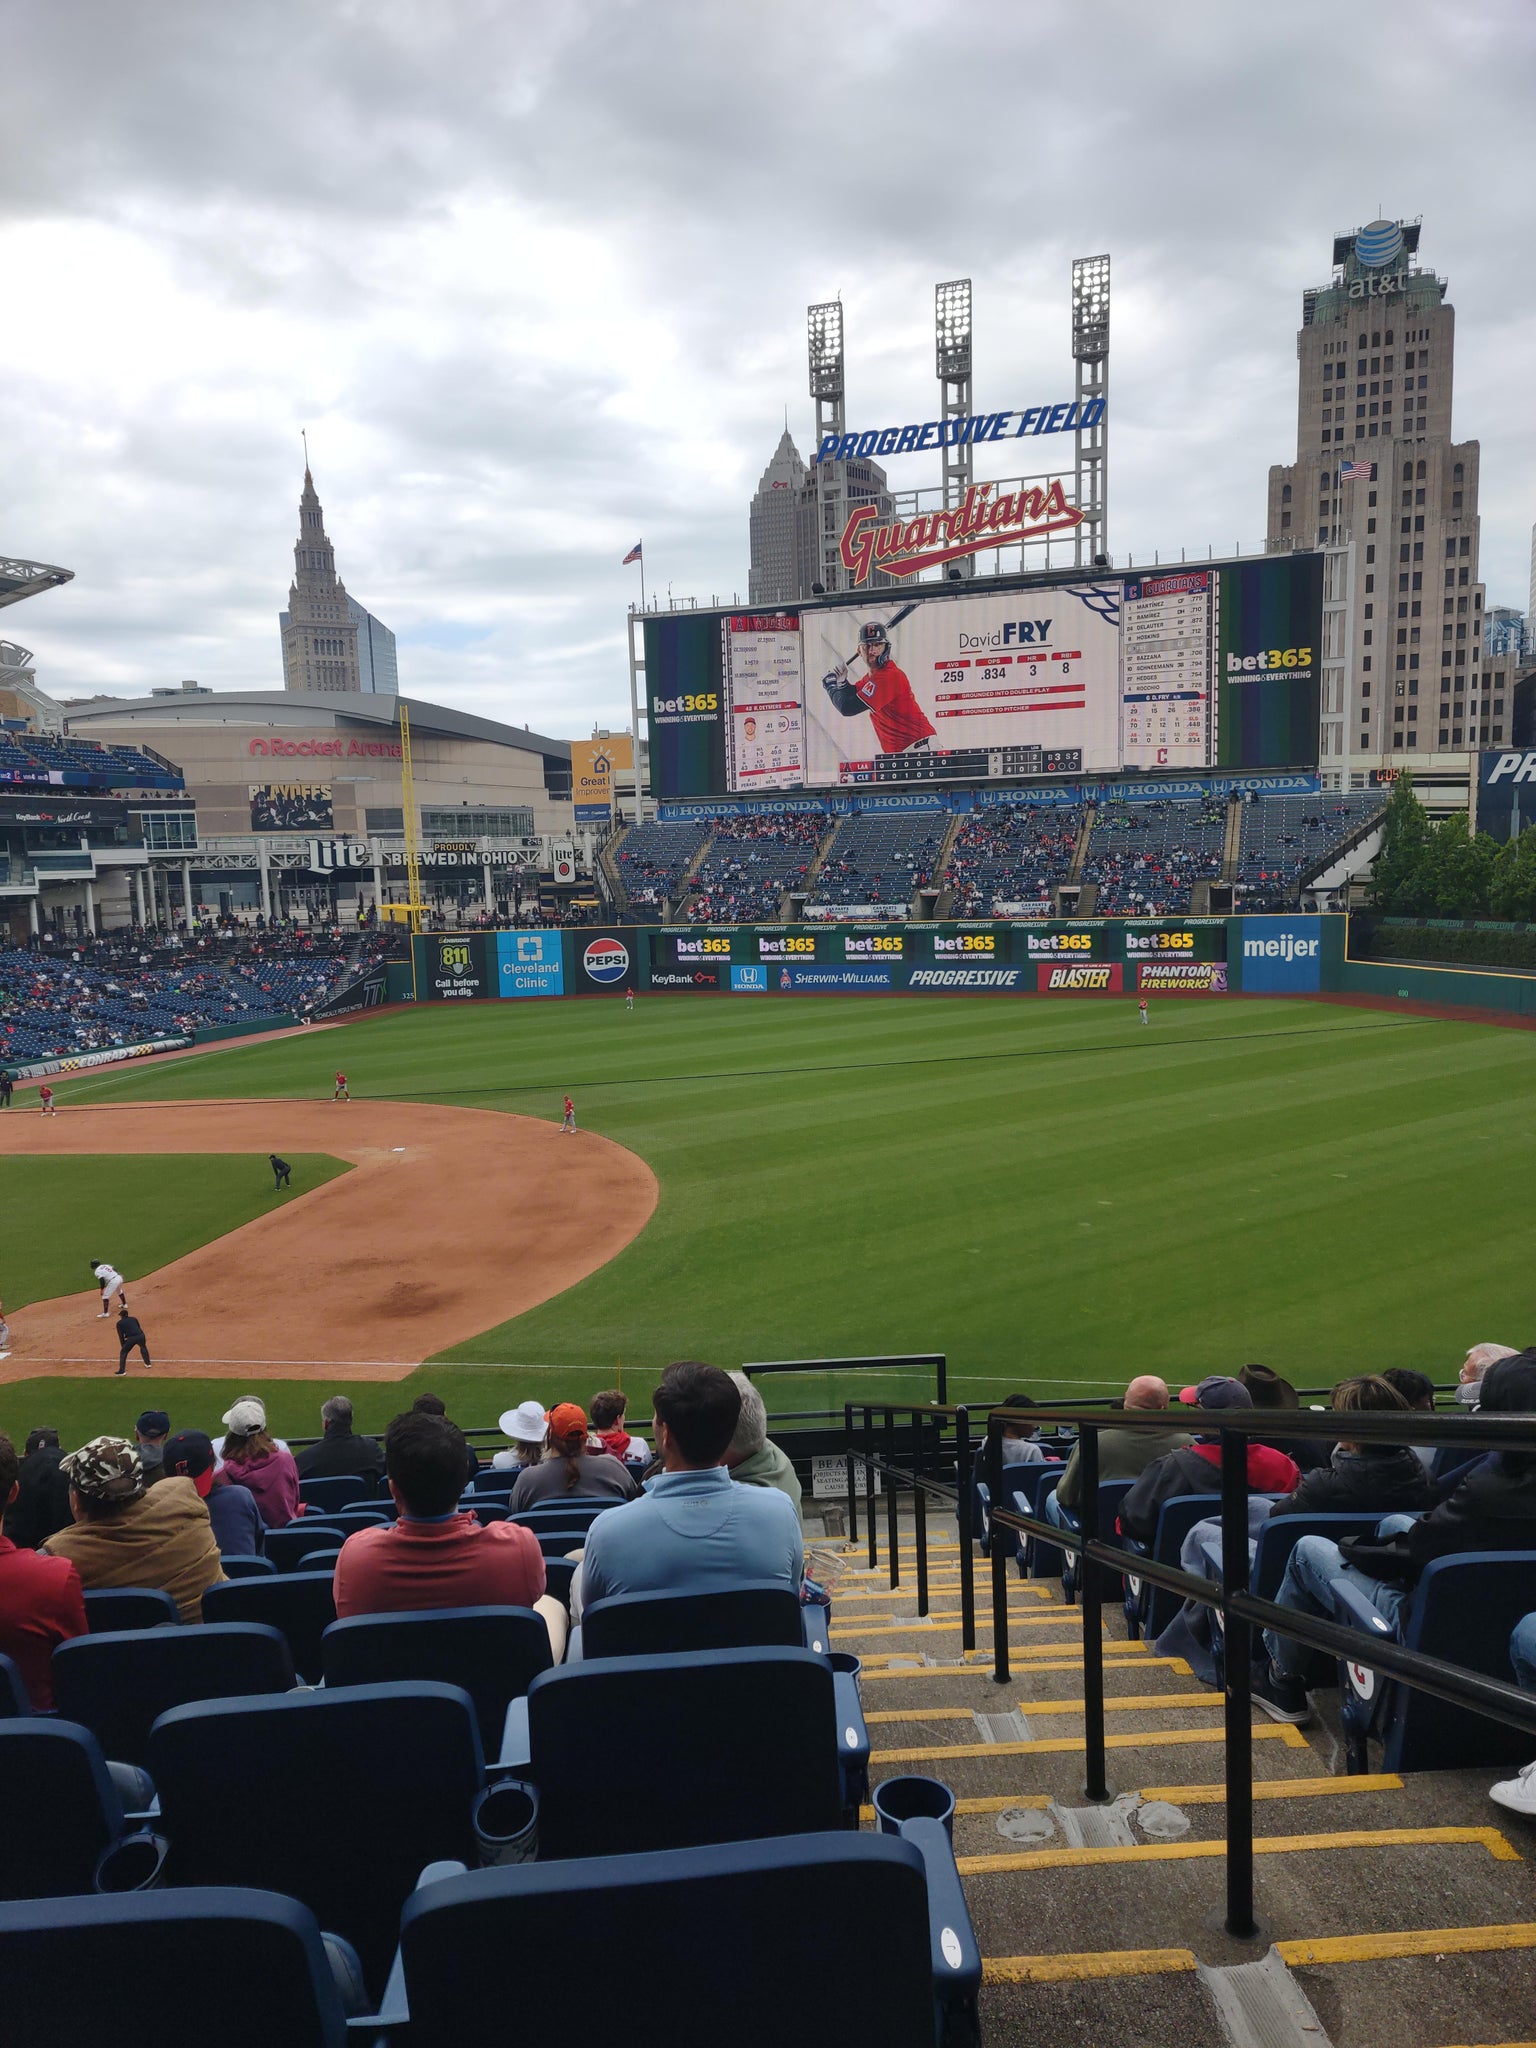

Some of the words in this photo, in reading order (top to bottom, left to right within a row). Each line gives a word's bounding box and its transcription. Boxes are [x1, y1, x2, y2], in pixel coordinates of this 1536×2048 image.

[1349, 267, 1407, 299] at&t
[816, 411, 1013, 463] PROGRESSIVE
[1017, 398, 1106, 437] FIELD
[840, 478, 1086, 586] Guardians
[1146, 576, 1202, 595] GUARDIANS
[960, 630, 1000, 648] David
[1003, 619, 1052, 644] FRY
[1227, 648, 1312, 671] bet365
[940, 670, 964, 683] .259
[981, 667, 1006, 680] .834
[1030, 665, 1036, 676] 3
[1062, 662, 1069, 674] 8
[654, 694, 717, 713] bet365
[270, 738, 343, 756] Rocket
[347, 739, 402, 757] Arena
[1157, 748, 1168, 764] C
[580, 777, 606, 786] Great
[1128, 782, 1203, 795] HONDA
[1229, 776, 1309, 790] HONDA
[249, 784, 332, 801] PLAYOFFS
[999, 789, 1069, 800] HONDA
[760, 800, 822, 813] HONDA
[874, 795, 941, 807] HONDA
[680, 804, 737, 816] HONDA
[434, 843, 475, 851] PROUDLY
[305, 839, 366, 874] Lite
[392, 852, 457, 866] BREWED
[462, 852, 477, 865] IN
[482, 851, 518, 865] OHIO
[555, 850, 572, 861] Lite
[677, 938, 730, 953] bet365
[759, 938, 815, 951] bet365
[845, 937, 903, 952] bet365
[934, 936, 995, 950] bet365
[1028, 934, 1092, 950] bet365
[1126, 933, 1194, 948] bet365
[1244, 934, 1316, 961] meijer
[442, 946, 468, 965] 811
[586, 955, 626, 966] PEPSI
[503, 962, 559, 975] Cleveland
[1142, 966, 1212, 977] PHANTOM
[515, 978, 548, 988] Clinic
[652, 974, 693, 985] KeyBank
[909, 970, 1018, 985] PROGRESSIVE
[1049, 969, 1110, 988] BLASTER
[1140, 979, 1210, 989] FIREWORKS
[443, 989, 457, 998] you
[459, 988, 473, 996] dig.
[80, 1050, 136, 1067] CONRAD'S
[818, 1460, 832, 1468] BE
